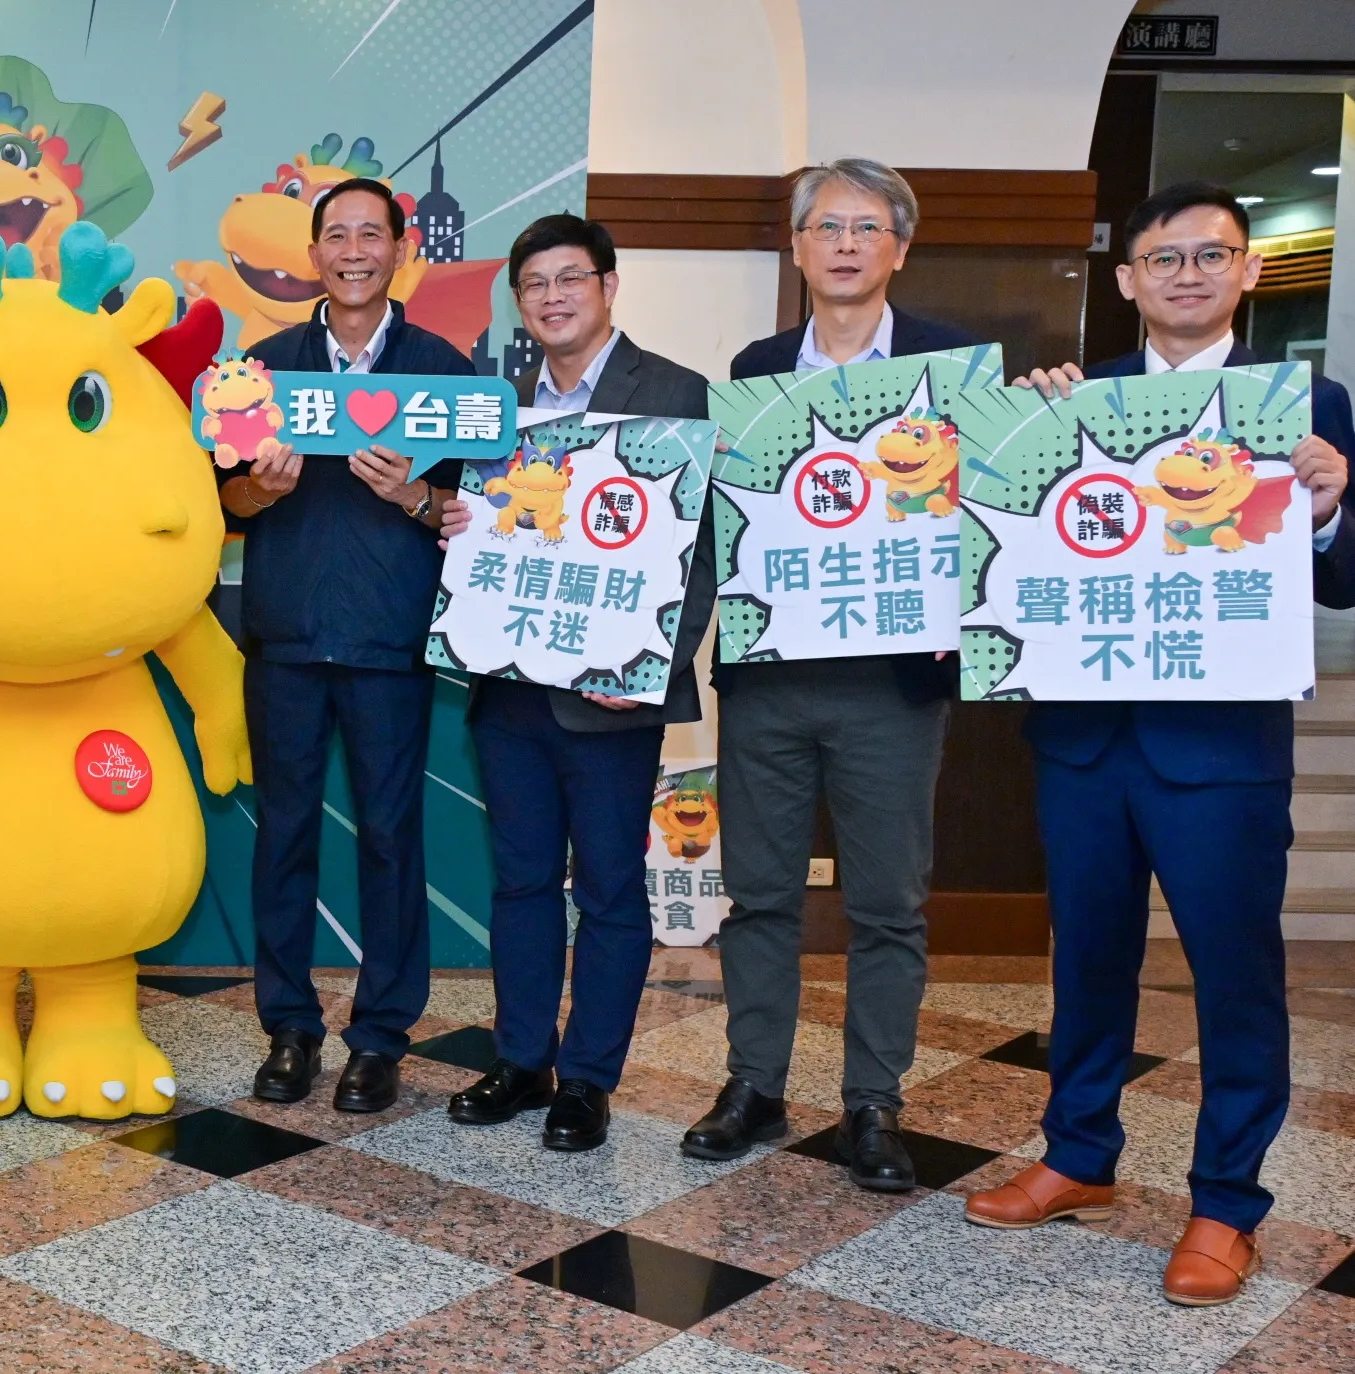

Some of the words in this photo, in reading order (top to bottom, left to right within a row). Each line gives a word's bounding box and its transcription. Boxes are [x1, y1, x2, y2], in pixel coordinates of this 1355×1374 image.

[1126, 22, 1211, 48] 演講廳
[288, 387, 337, 436] 我
[402, 391, 503, 440] 台壽
[811, 468, 852, 491] 付款
[599, 491, 635, 512] 情感
[812, 491, 853, 514] 詐騙
[1077, 493, 1125, 516] 偽裝
[594, 513, 630, 534] 詐騙
[1077, 519, 1125, 542] 詐騙
[764, 533, 961, 593] 陌生指示
[468, 550, 647, 613] 柔情騙財
[1015, 568, 1274, 625] 聲稱檢警
[821, 588, 926, 639] 不聽
[503, 604, 589, 656] 不迷
[1080, 630, 1206, 682] 不慌
[101, 742, 125, 757] We
[87, 755, 149, 789] Family
[644, 868, 727, 897] 商品
